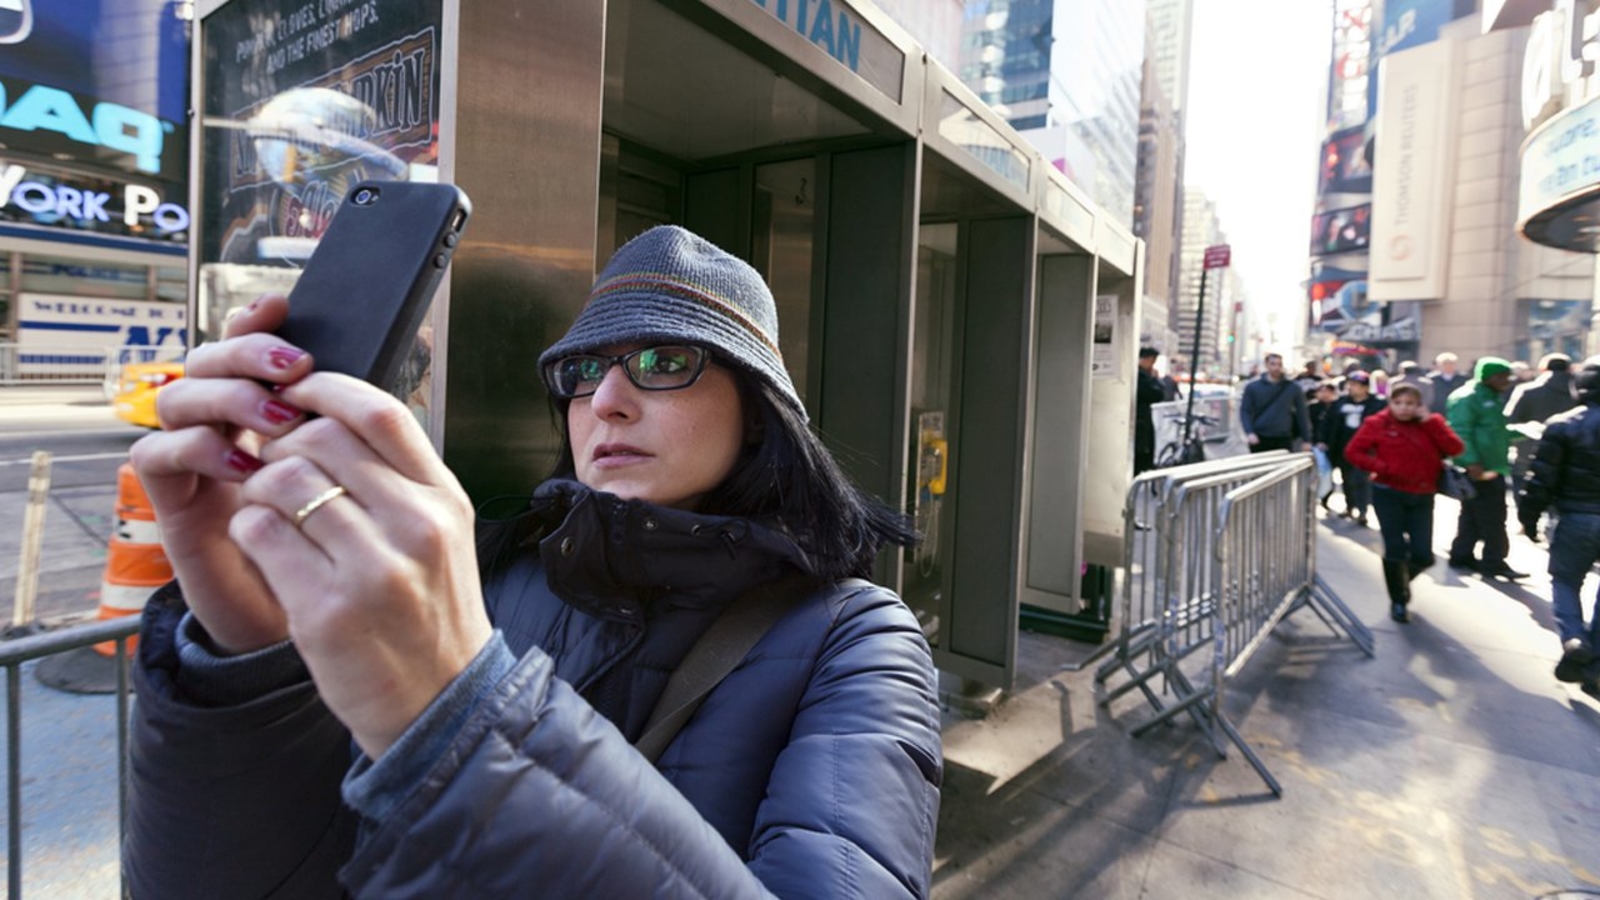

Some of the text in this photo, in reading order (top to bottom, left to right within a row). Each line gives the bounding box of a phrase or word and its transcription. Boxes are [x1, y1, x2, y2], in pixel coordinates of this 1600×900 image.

[754, 0, 861, 73] TAN
[0, 81, 165, 174] AQ
[0, 164, 111, 222] YORK
